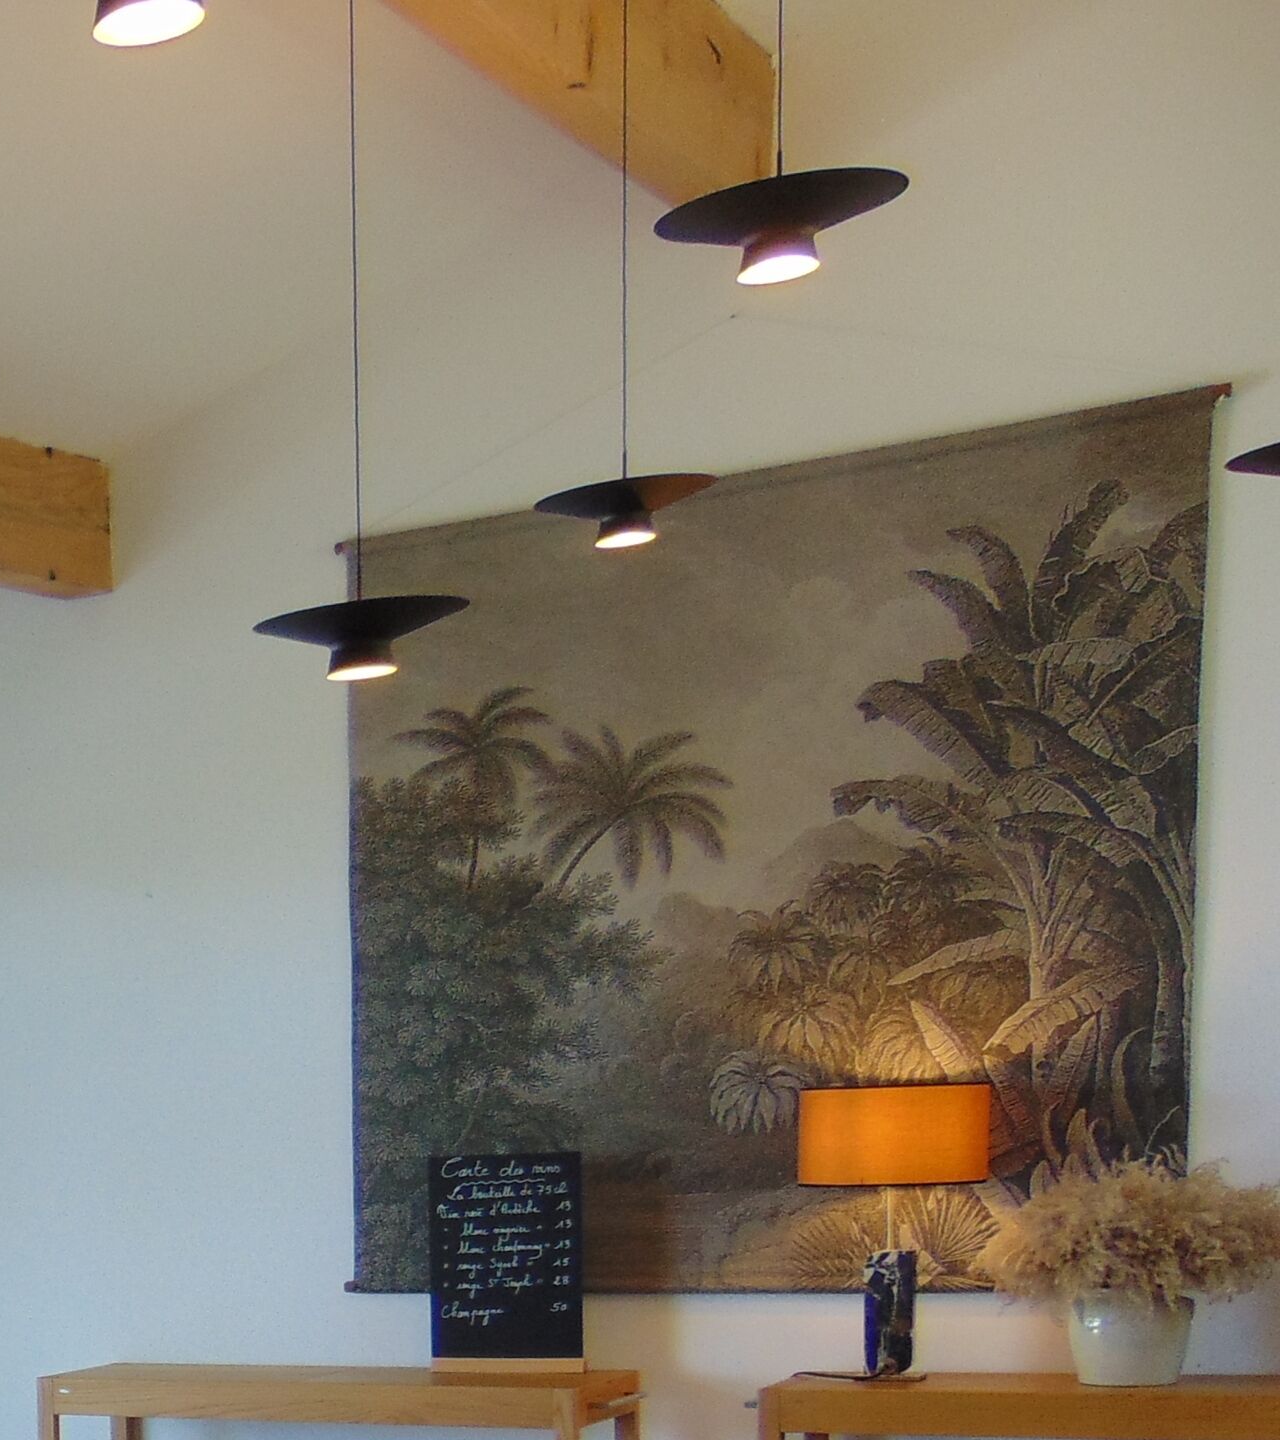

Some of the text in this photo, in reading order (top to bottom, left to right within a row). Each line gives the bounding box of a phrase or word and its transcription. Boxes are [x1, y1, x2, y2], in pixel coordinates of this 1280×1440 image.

[441, 1156, 561, 1178] Carte des vins
[446, 1185, 465, 1200] La
[468, 1186, 517, 1200] bouteille
[520, 1186, 534, 1196] de
[436, 1203, 460, 1219] Vin
[555, 1201, 572, 1211] 13
[460, 1222, 489, 1237] blanc
[554, 1219, 573, 1229] 13
[457, 1240, 485, 1254] blanc
[554, 1240, 571, 1250] 13
[456, 1263, 485, 1279] rouge
[552, 1257, 571, 1267] 15
[456, 1283, 484, 1299] rouge
[553, 1276, 570, 1286] 28
[441, 1301, 568, 1327] Champagne 50
